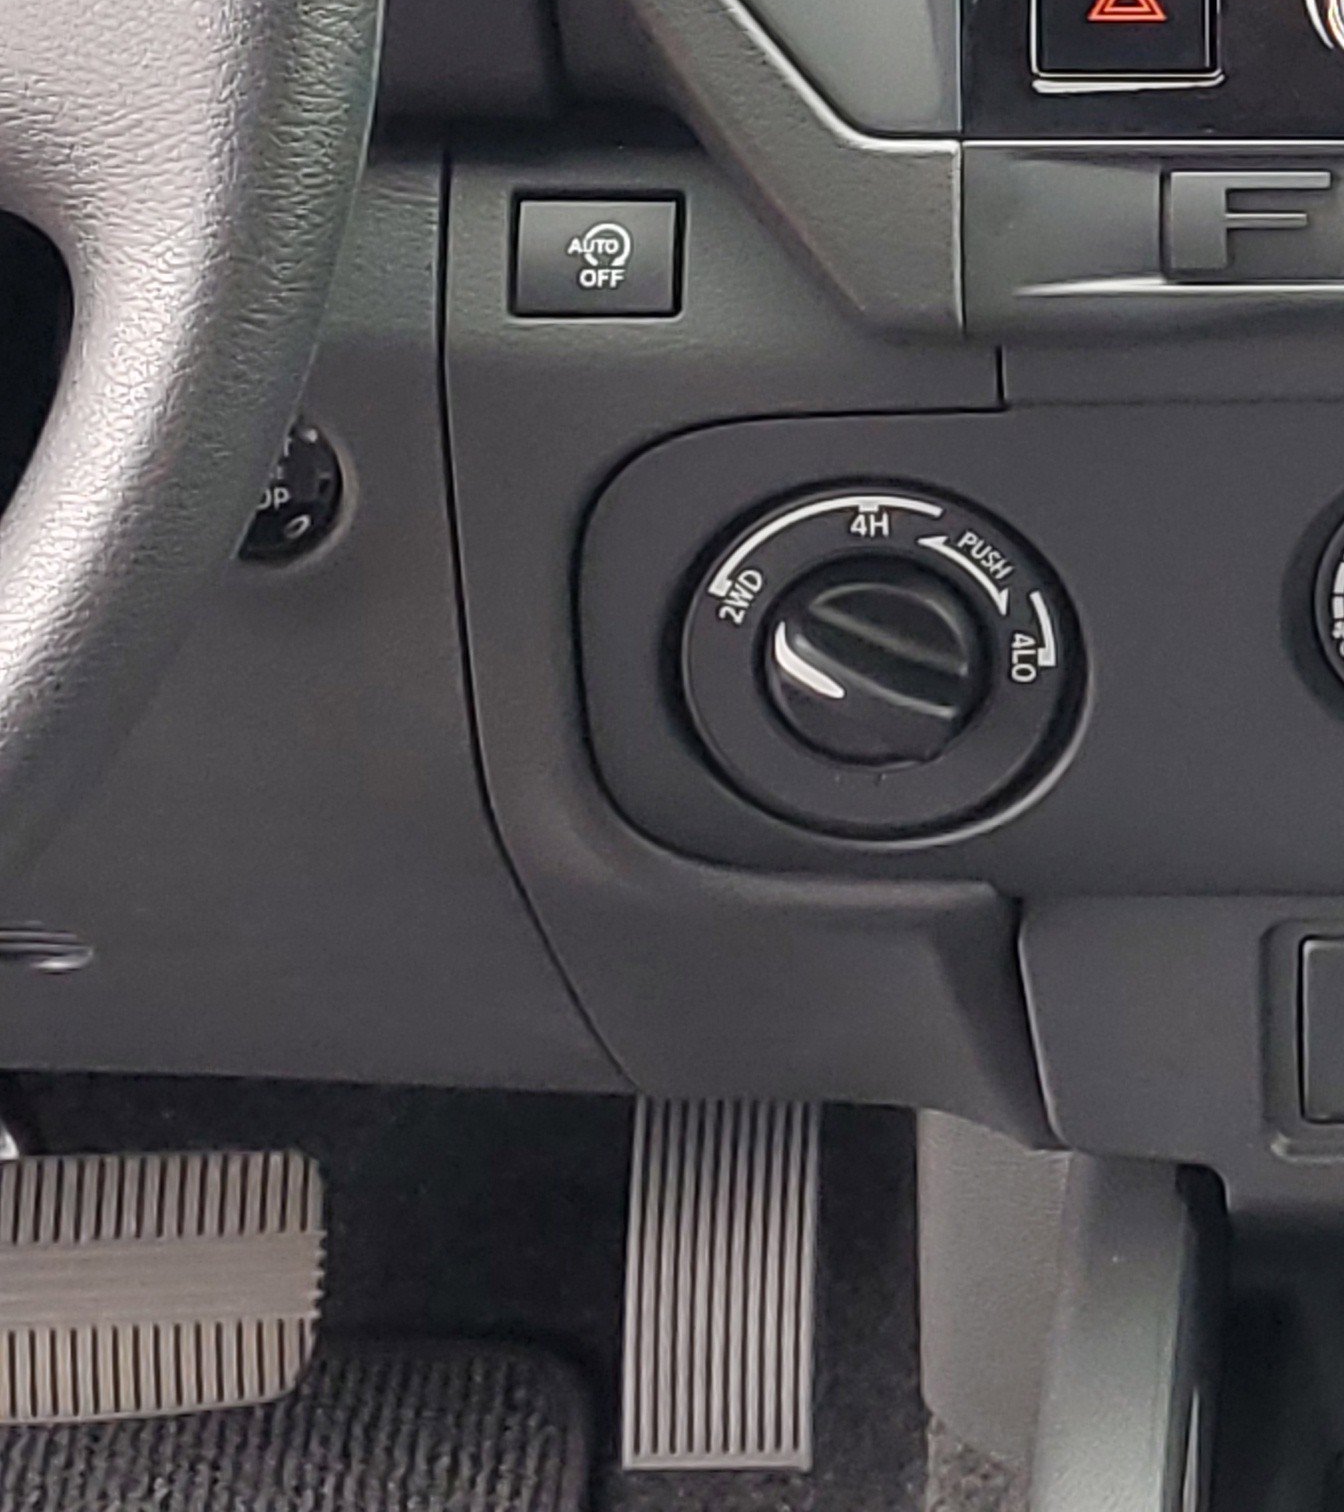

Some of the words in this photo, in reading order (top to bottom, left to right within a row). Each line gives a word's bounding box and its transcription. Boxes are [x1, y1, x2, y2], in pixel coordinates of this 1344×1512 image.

[566, 237, 620, 255] AUTO
[579, 268, 626, 289] OFF
[849, 511, 890, 537] 4H
[957, 530, 1015, 581] PUSH
[718, 568, 763, 625] 2WD
[1010, 632, 1037, 683] 4LO
